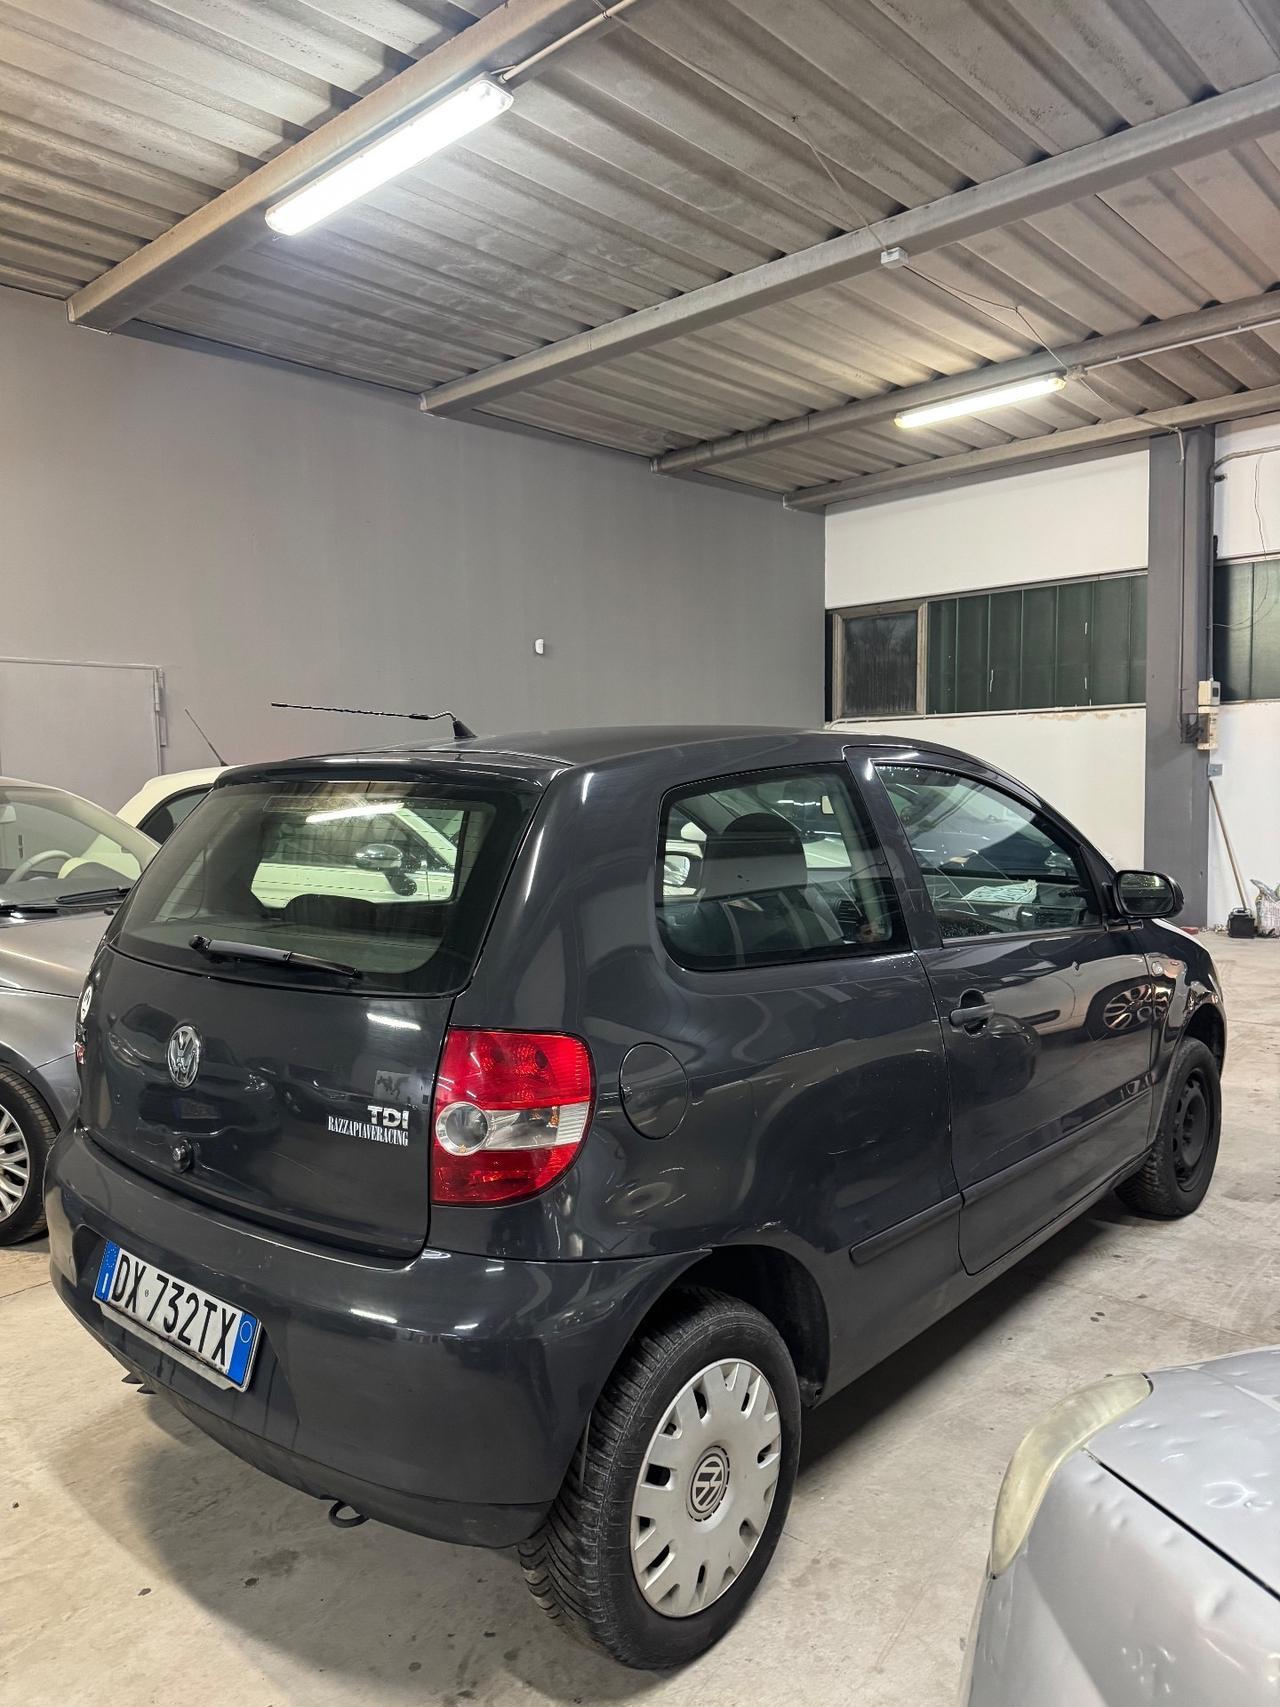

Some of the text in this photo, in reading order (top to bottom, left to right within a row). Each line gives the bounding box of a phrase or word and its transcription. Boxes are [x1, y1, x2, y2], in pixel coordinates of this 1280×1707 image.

[367, 1105, 410, 1129] TDI
[112, 1254, 237, 1366] DX 732TX
